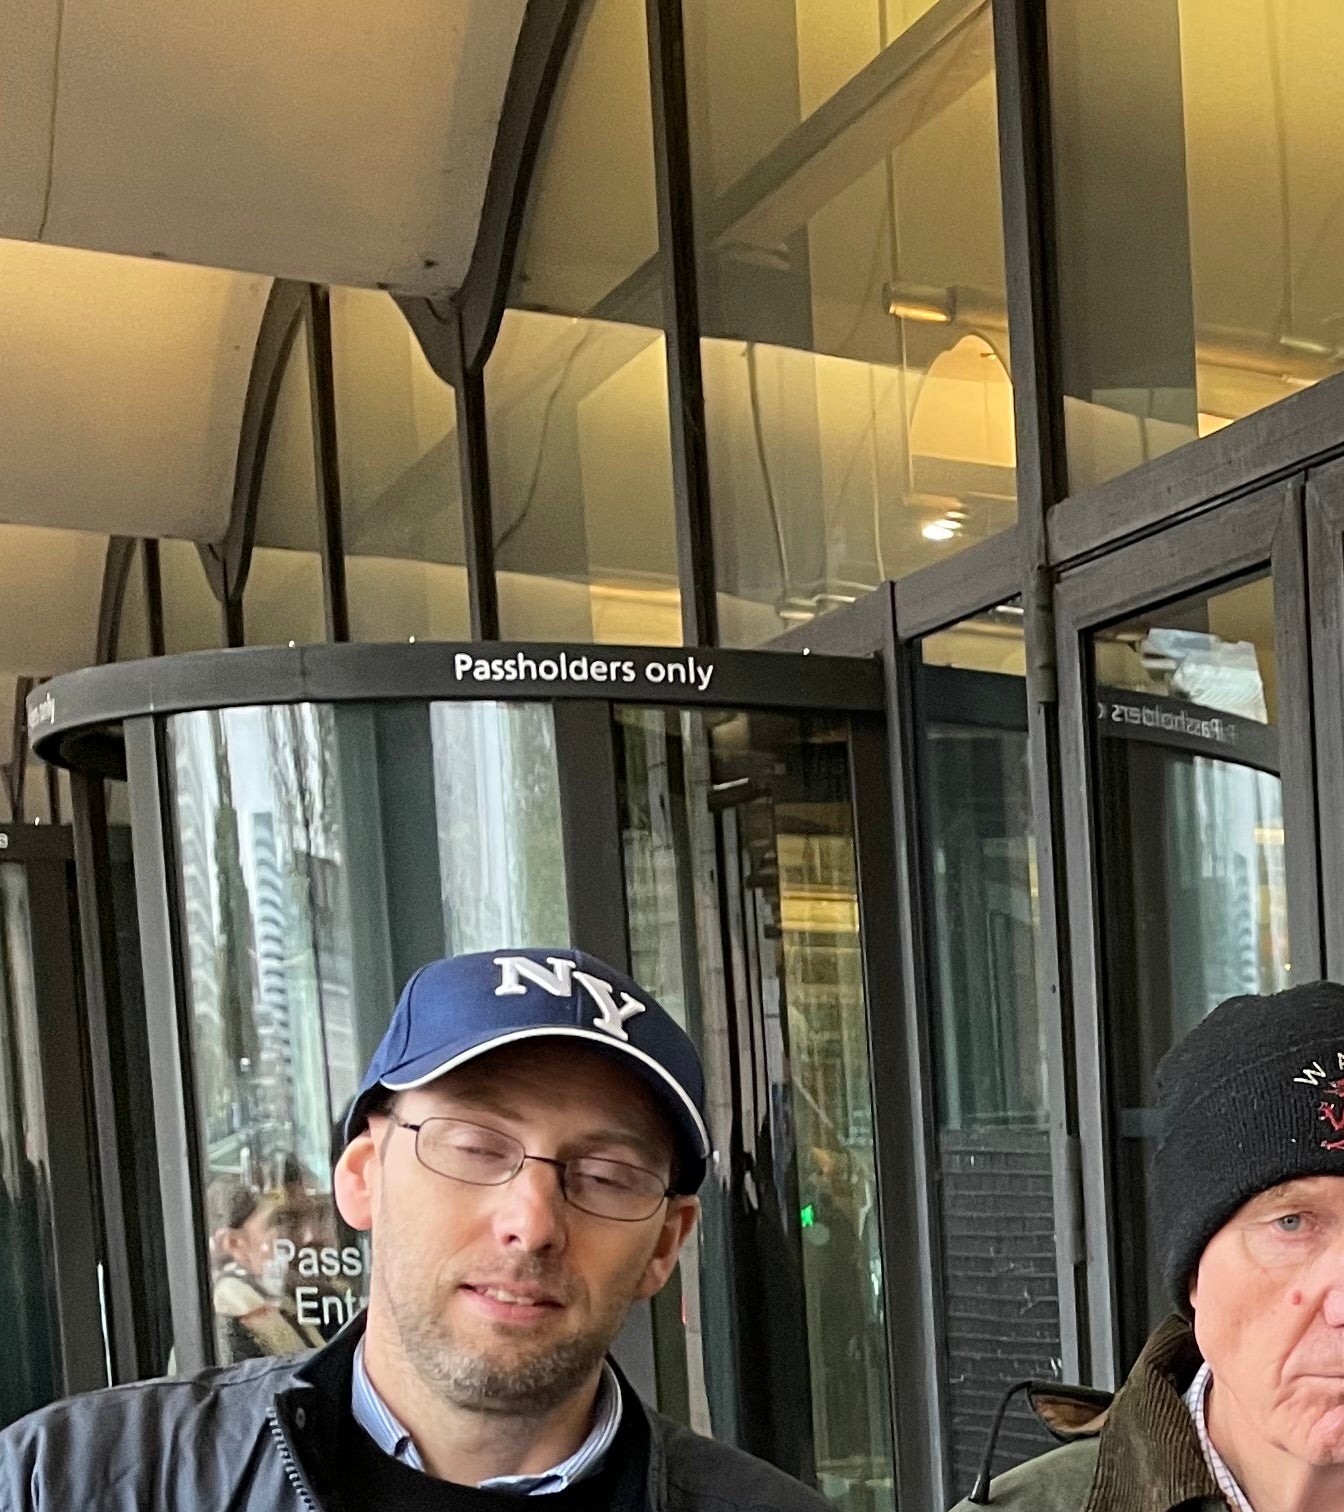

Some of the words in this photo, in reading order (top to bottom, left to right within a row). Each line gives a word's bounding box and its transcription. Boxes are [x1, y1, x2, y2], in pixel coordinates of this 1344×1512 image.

[454, 652, 637, 683] Passholders
[645, 656, 714, 690] only
[493, 956, 646, 1041] NY
